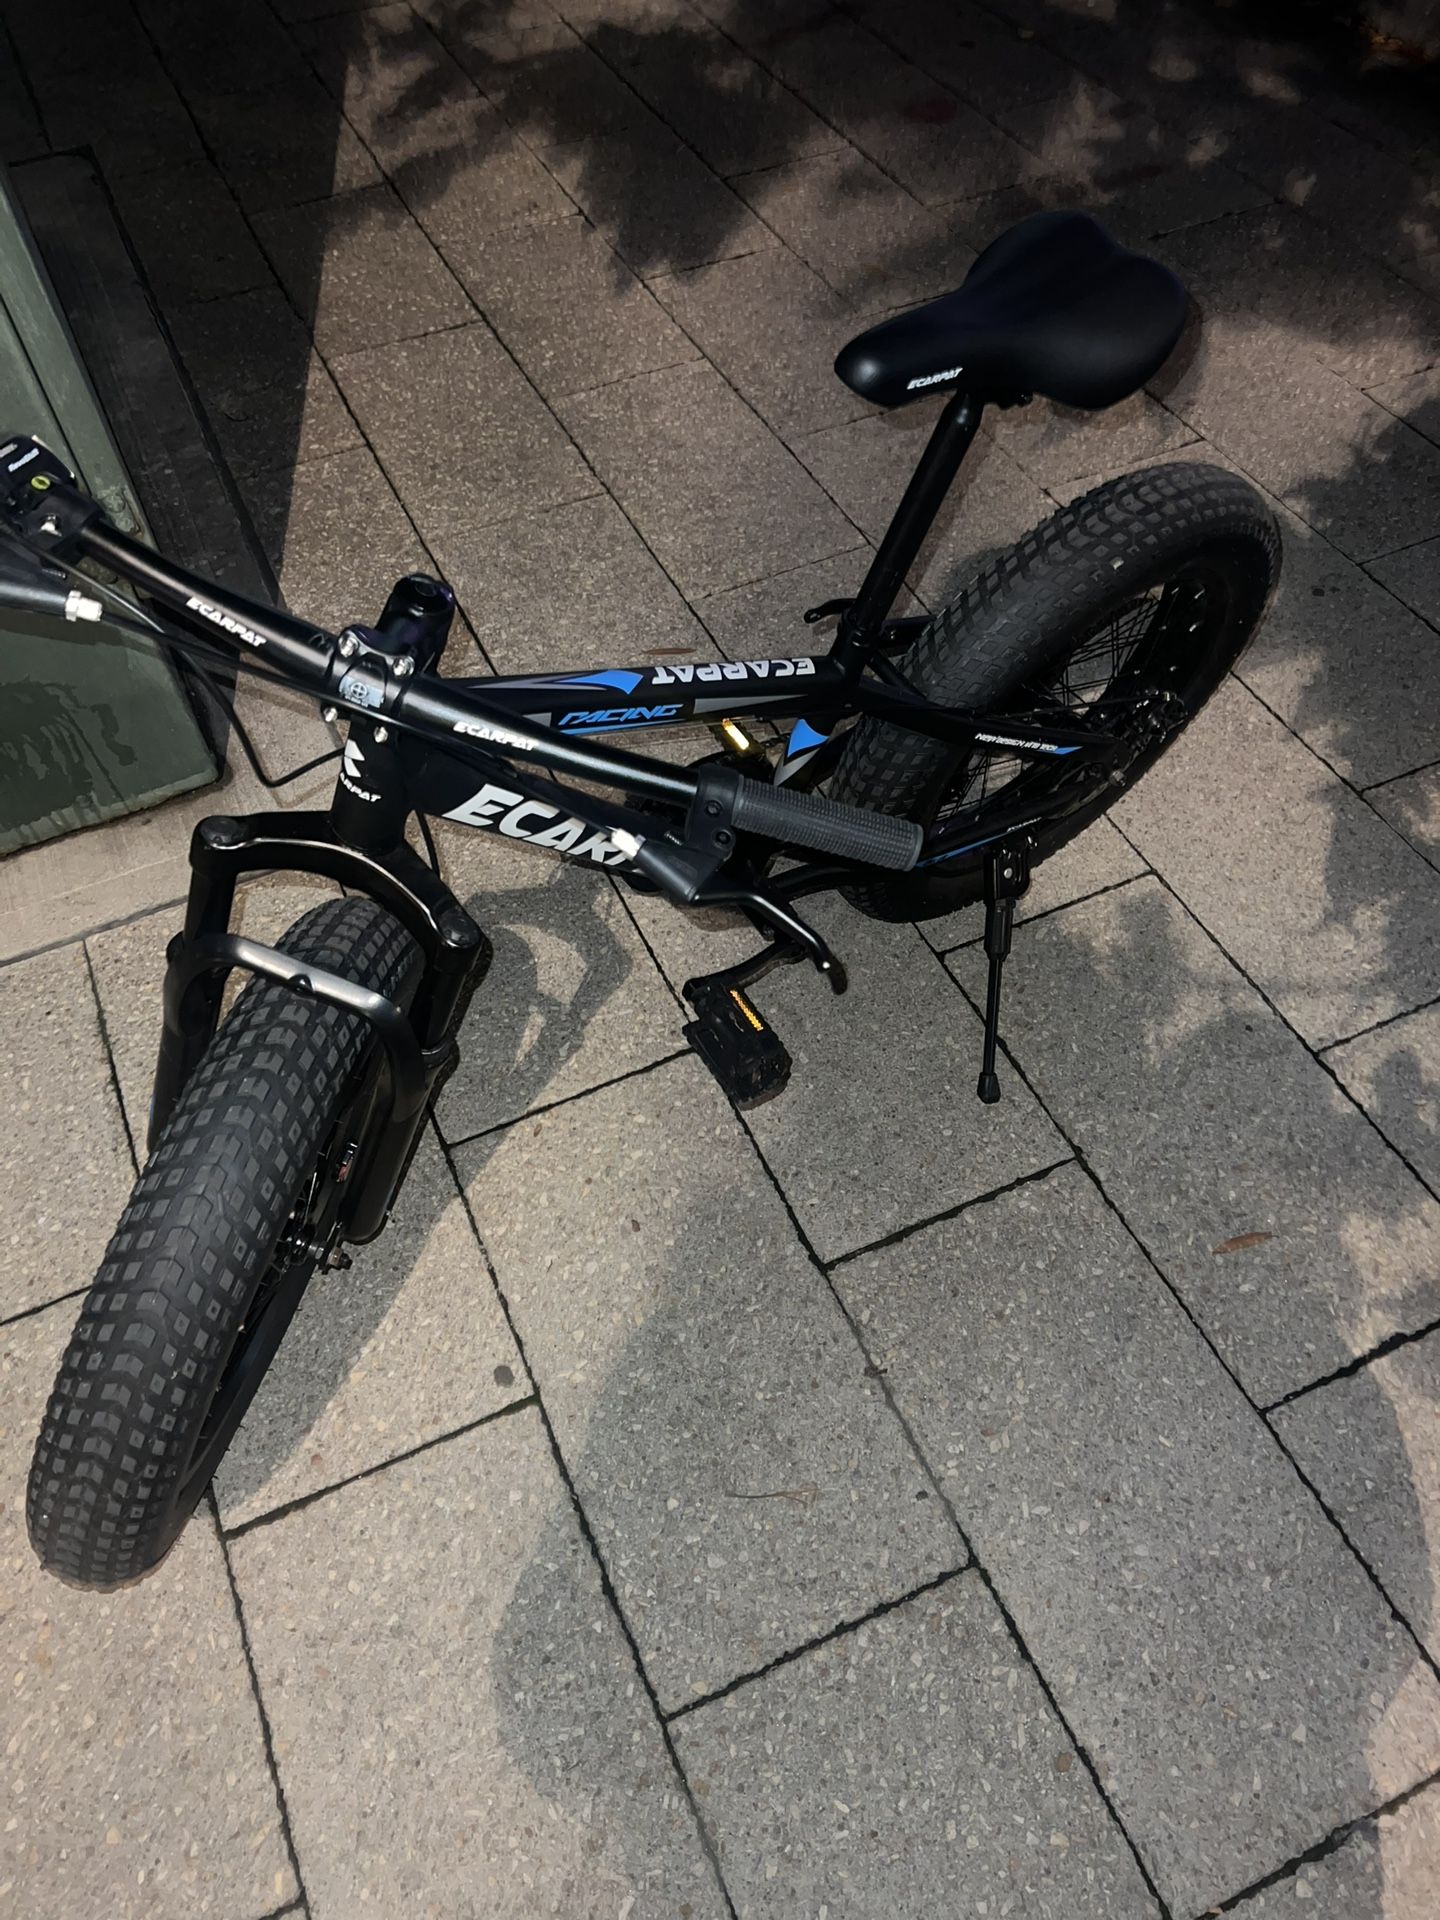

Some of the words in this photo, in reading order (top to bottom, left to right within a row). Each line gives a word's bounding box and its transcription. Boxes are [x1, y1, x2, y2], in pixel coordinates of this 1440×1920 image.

[907, 367, 963, 390] ECARPAT
[186, 596, 267, 647] ECARPAT
[652, 657, 816, 685] ECARPAT
[558, 703, 684, 726] RACING
[453, 720, 539, 752] ECARPAT
[340, 771, 382, 802] ARPAT
[441, 783, 628, 867] ECAR
